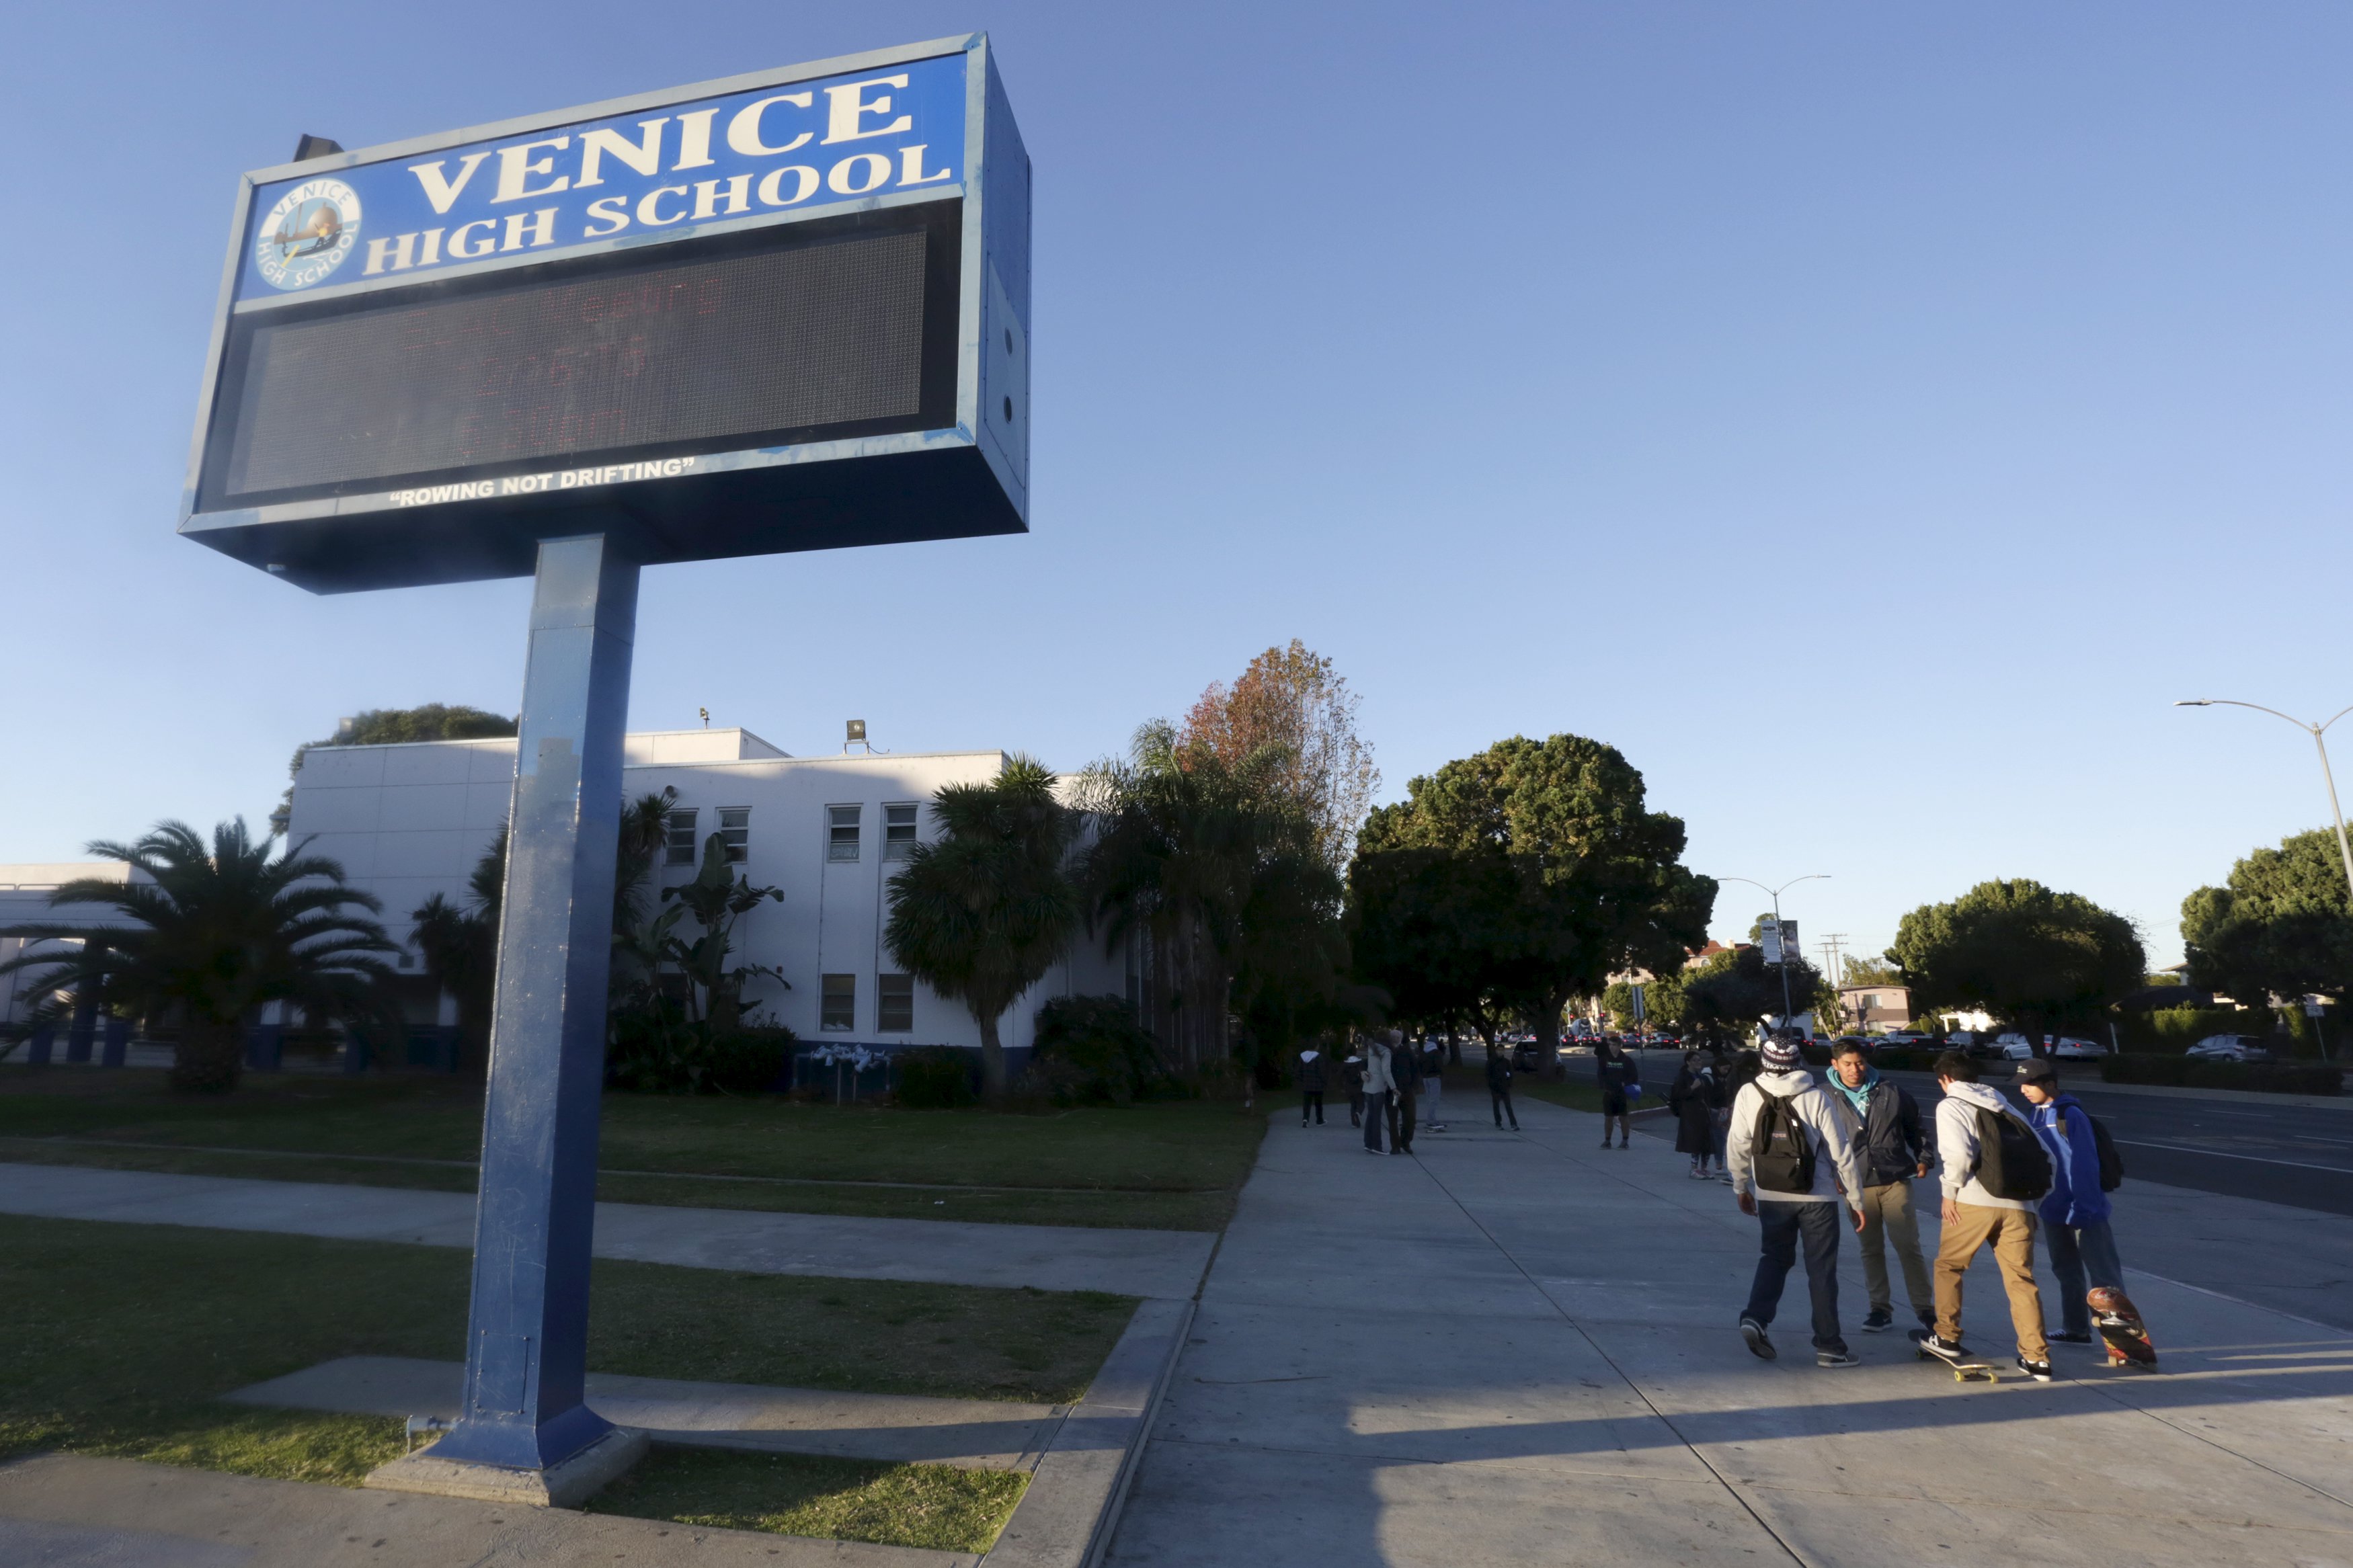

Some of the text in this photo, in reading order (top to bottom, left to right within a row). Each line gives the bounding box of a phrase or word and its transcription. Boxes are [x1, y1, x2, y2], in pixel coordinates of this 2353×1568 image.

[407, 74, 912, 214] VENICE
[274, 181, 352, 217] VENICE
[362, 145, 951, 275] HIGH SCHOOL
[258, 222, 358, 286] HIGH SCHOOL
[390, 456, 694, 506] “ROWING NOT DRIFTING”
